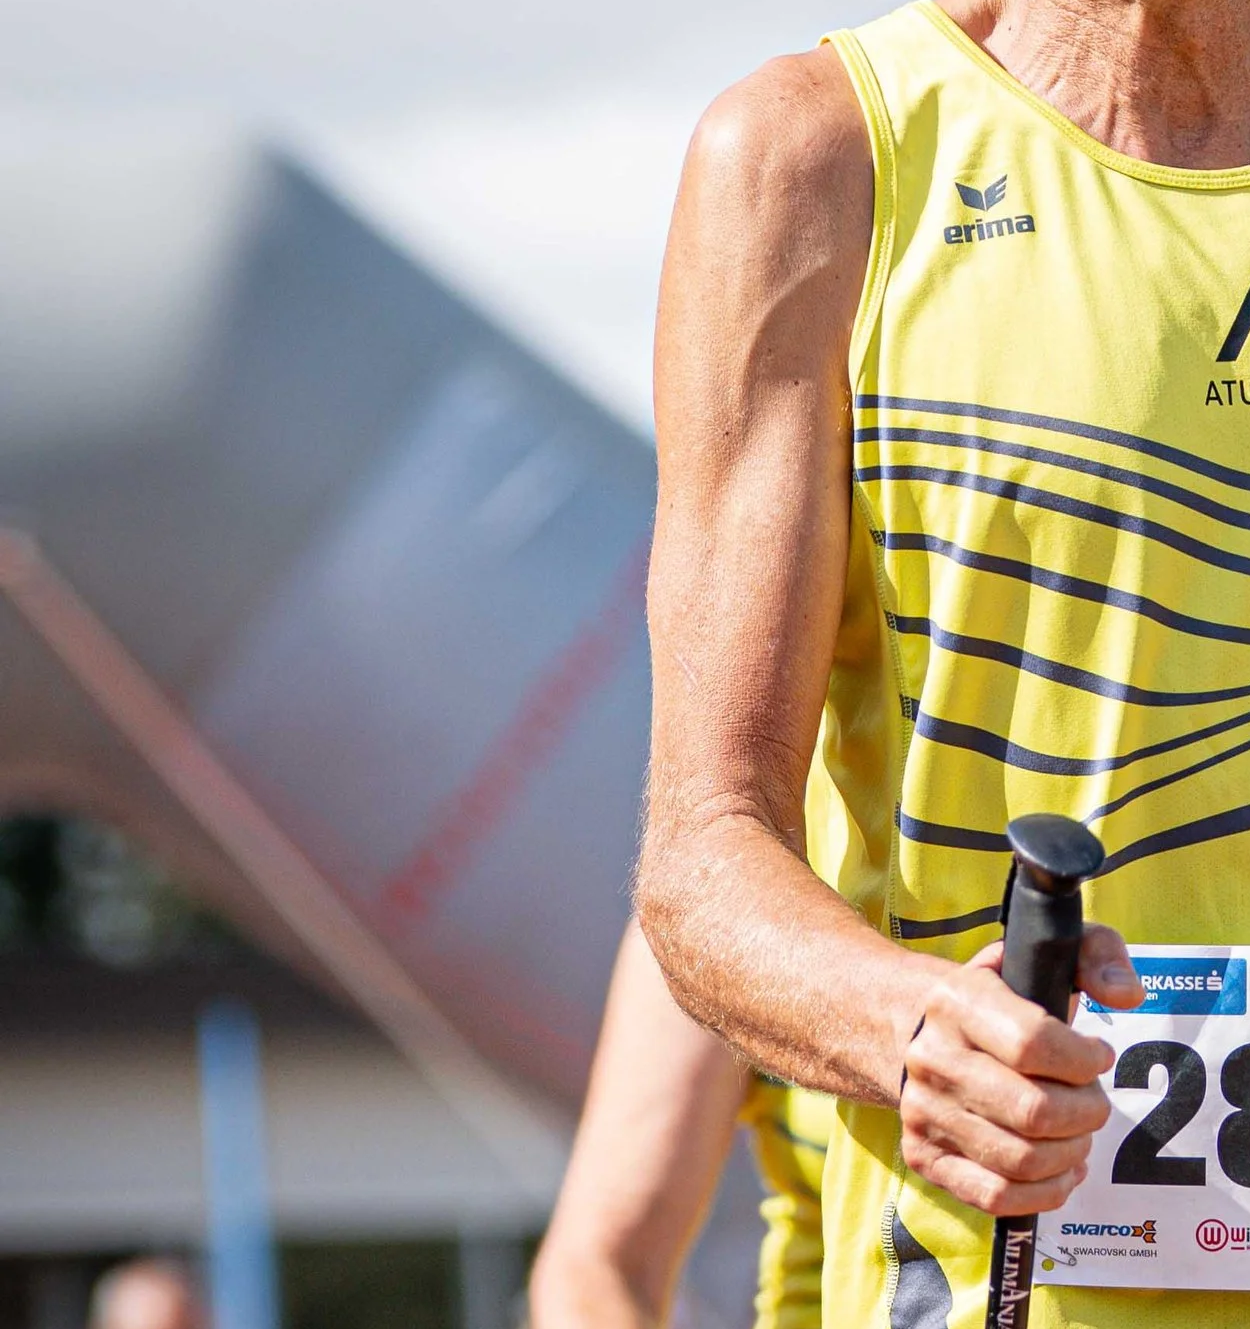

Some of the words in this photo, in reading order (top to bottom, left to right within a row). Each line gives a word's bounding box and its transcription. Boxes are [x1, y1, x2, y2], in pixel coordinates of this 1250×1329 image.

[943, 215, 1036, 245] erima
[1140, 975, 1204, 991] RKASSE
[1060, 1223, 1131, 1237] swarco
[1073, 1247, 1127, 1257] SWAROVSKI
[1129, 1249, 1158, 1259] GMBH
